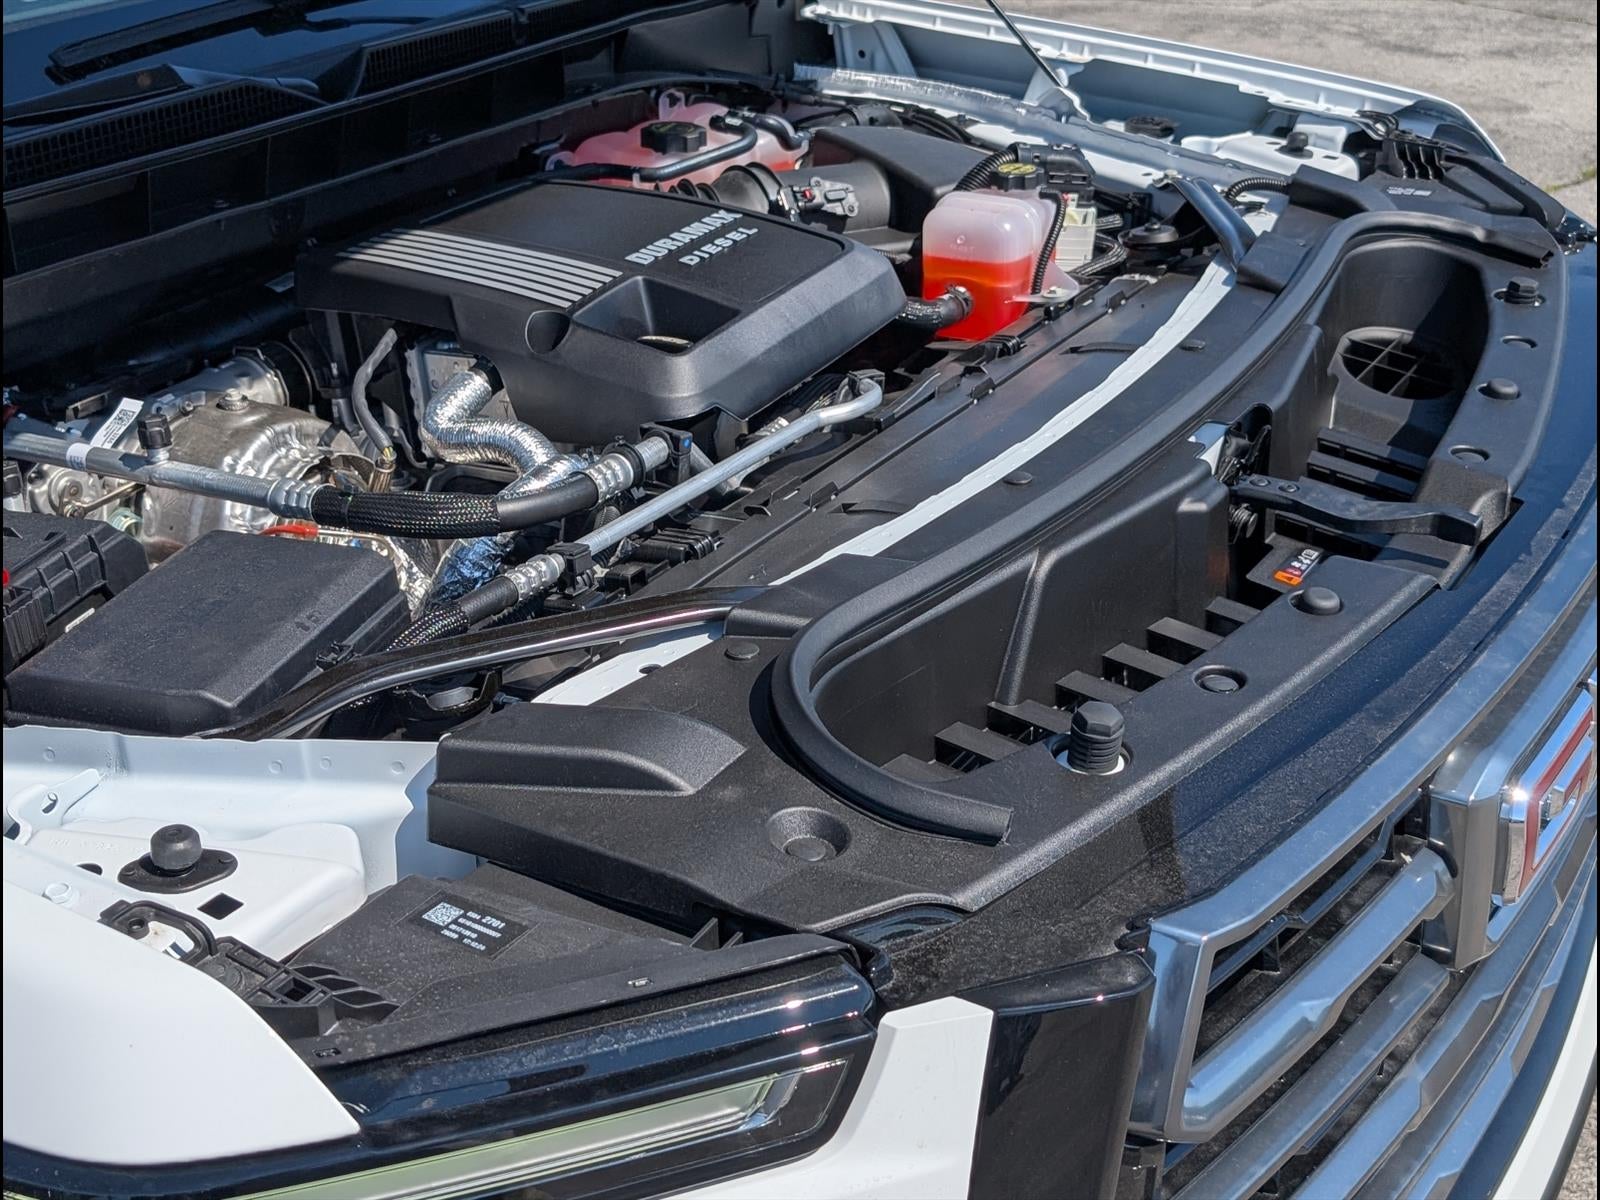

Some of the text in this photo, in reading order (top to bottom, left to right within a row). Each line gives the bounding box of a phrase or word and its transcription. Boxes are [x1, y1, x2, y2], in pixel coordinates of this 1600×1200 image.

[624, 209, 743, 265] DURAMAX
[678, 227, 759, 266] DIESEL
[481, 915, 506, 929] 2701
